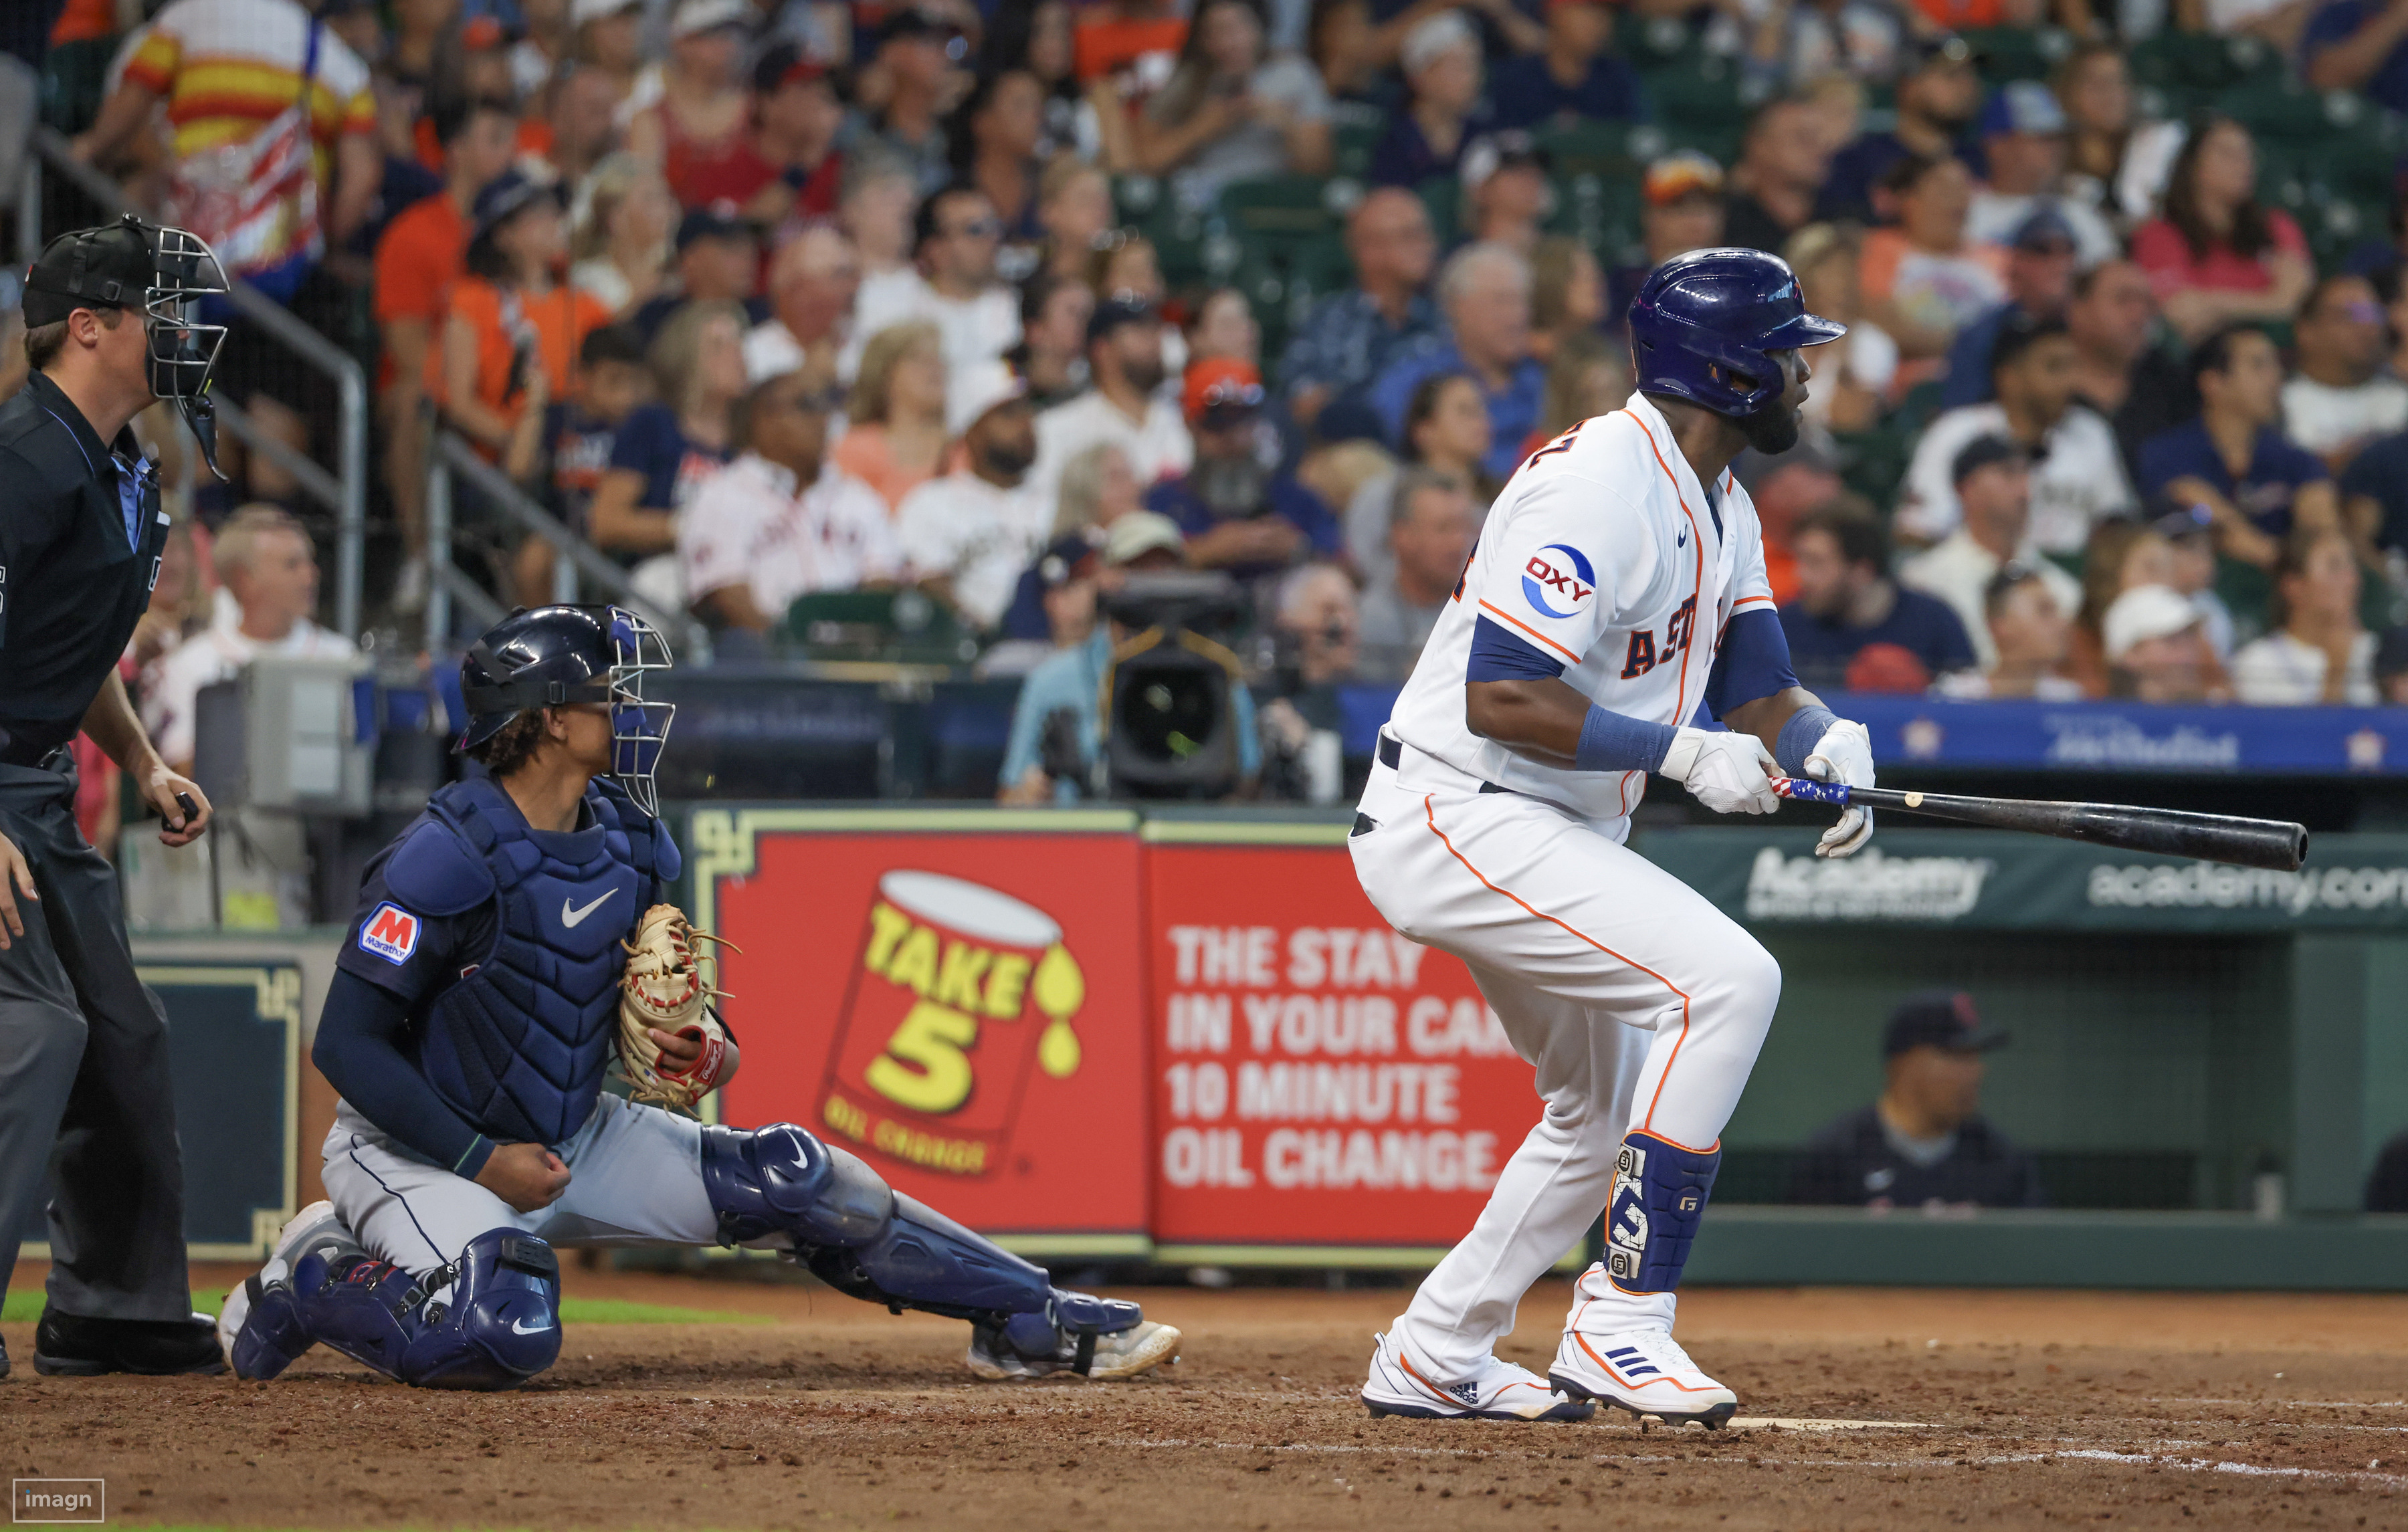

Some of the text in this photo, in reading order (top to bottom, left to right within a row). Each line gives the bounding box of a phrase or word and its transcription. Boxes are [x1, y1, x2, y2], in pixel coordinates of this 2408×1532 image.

[1526, 556, 1592, 602] OXY
[1620, 592, 1730, 680] AST
[365, 936, 405, 958] Marathon
[865, 902, 1032, 1020] TAKE
[1168, 925, 1426, 990] THE STAY
[1167, 994, 1232, 1054] IN
[1241, 994, 1398, 1056] YOUR
[864, 1001, 978, 1114] 5
[823, 1093, 869, 1143] OIL
[1167, 1061, 1461, 1124] 10 MINUTE
[1163, 1127, 1255, 1189] OIL
[1449, 1386, 1480, 1405] adidas
